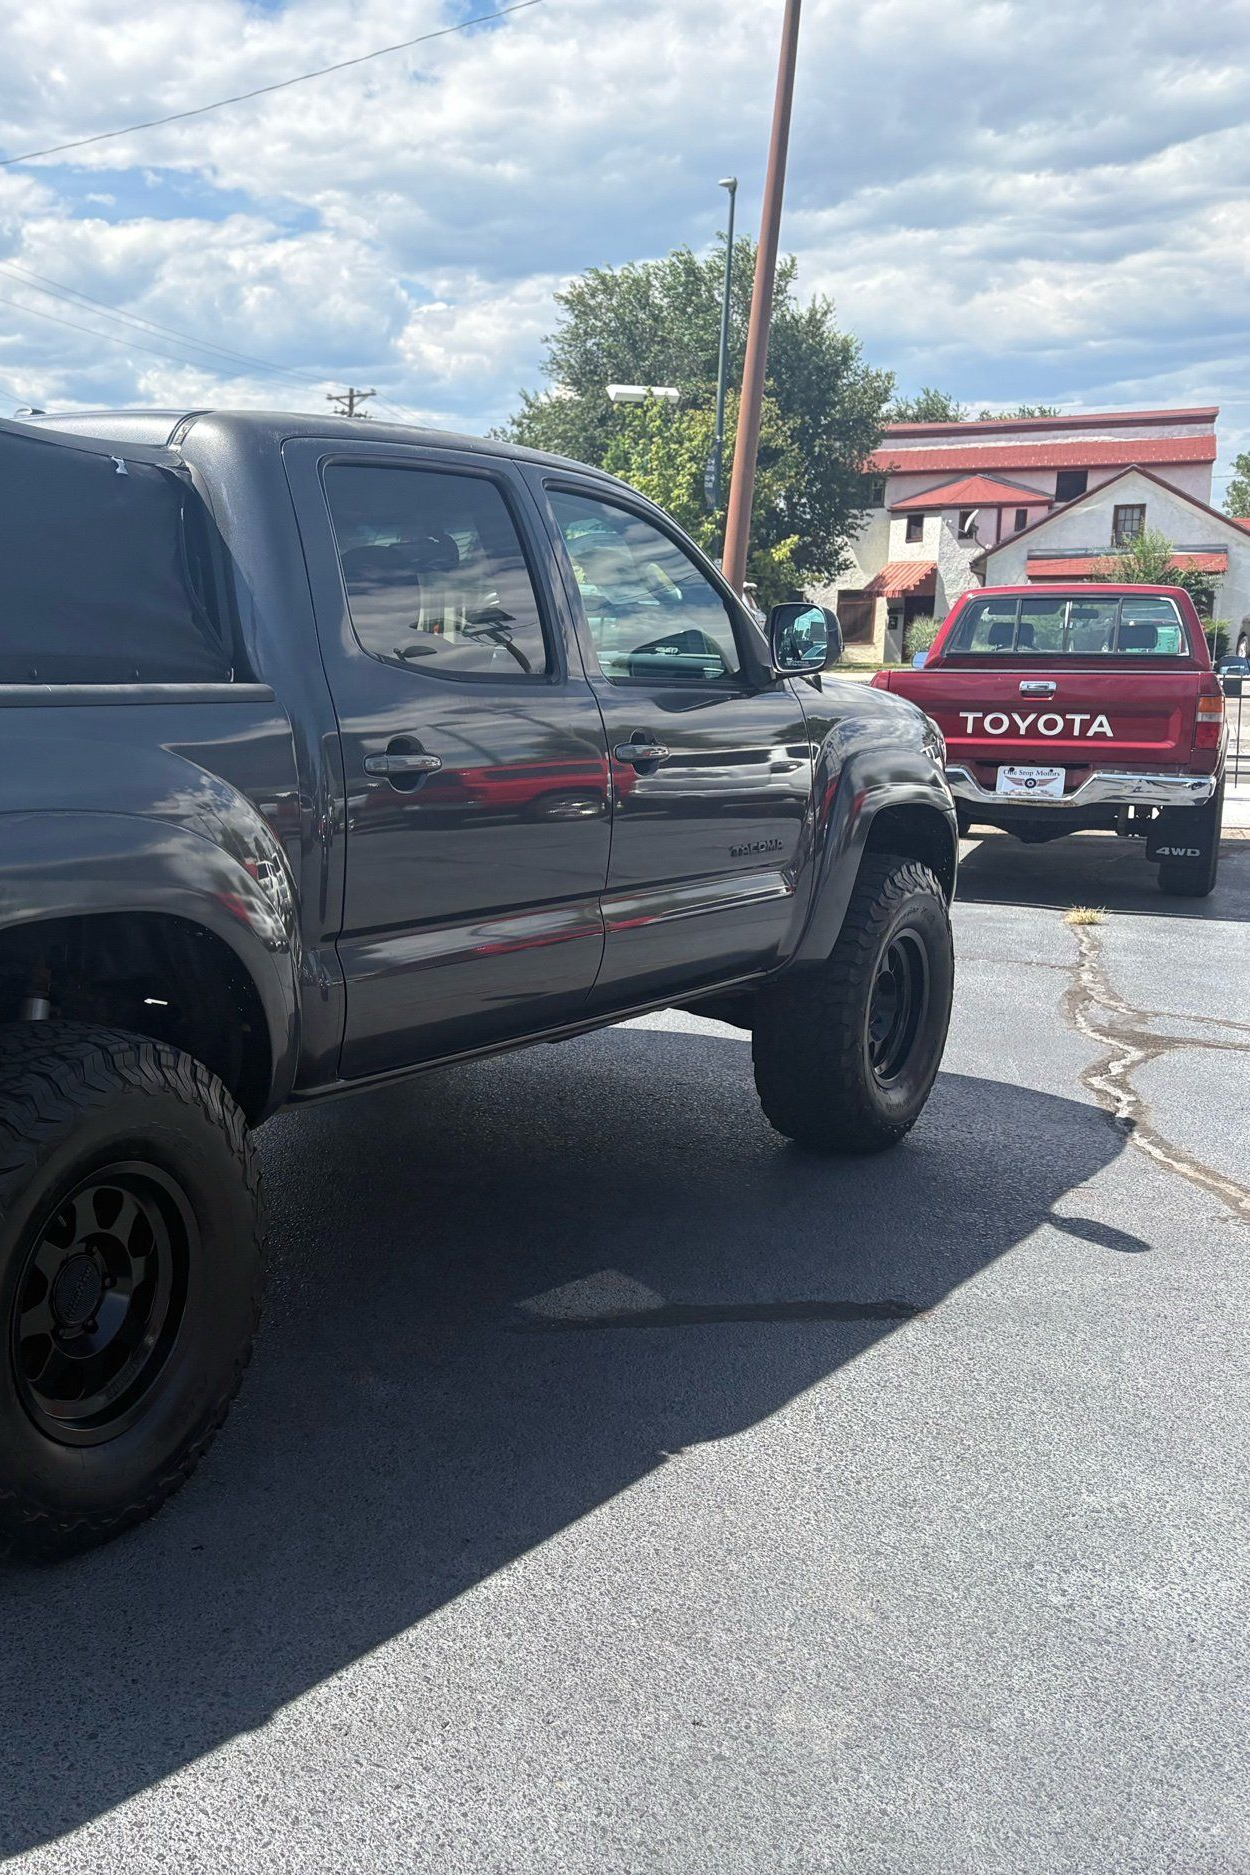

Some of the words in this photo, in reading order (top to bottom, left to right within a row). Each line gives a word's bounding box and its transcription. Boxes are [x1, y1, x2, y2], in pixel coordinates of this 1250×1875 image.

[959, 711, 1114, 738] TOYOTA
[729, 839, 783, 857] TACOMA
[1156, 847, 1200, 857] 4WD
